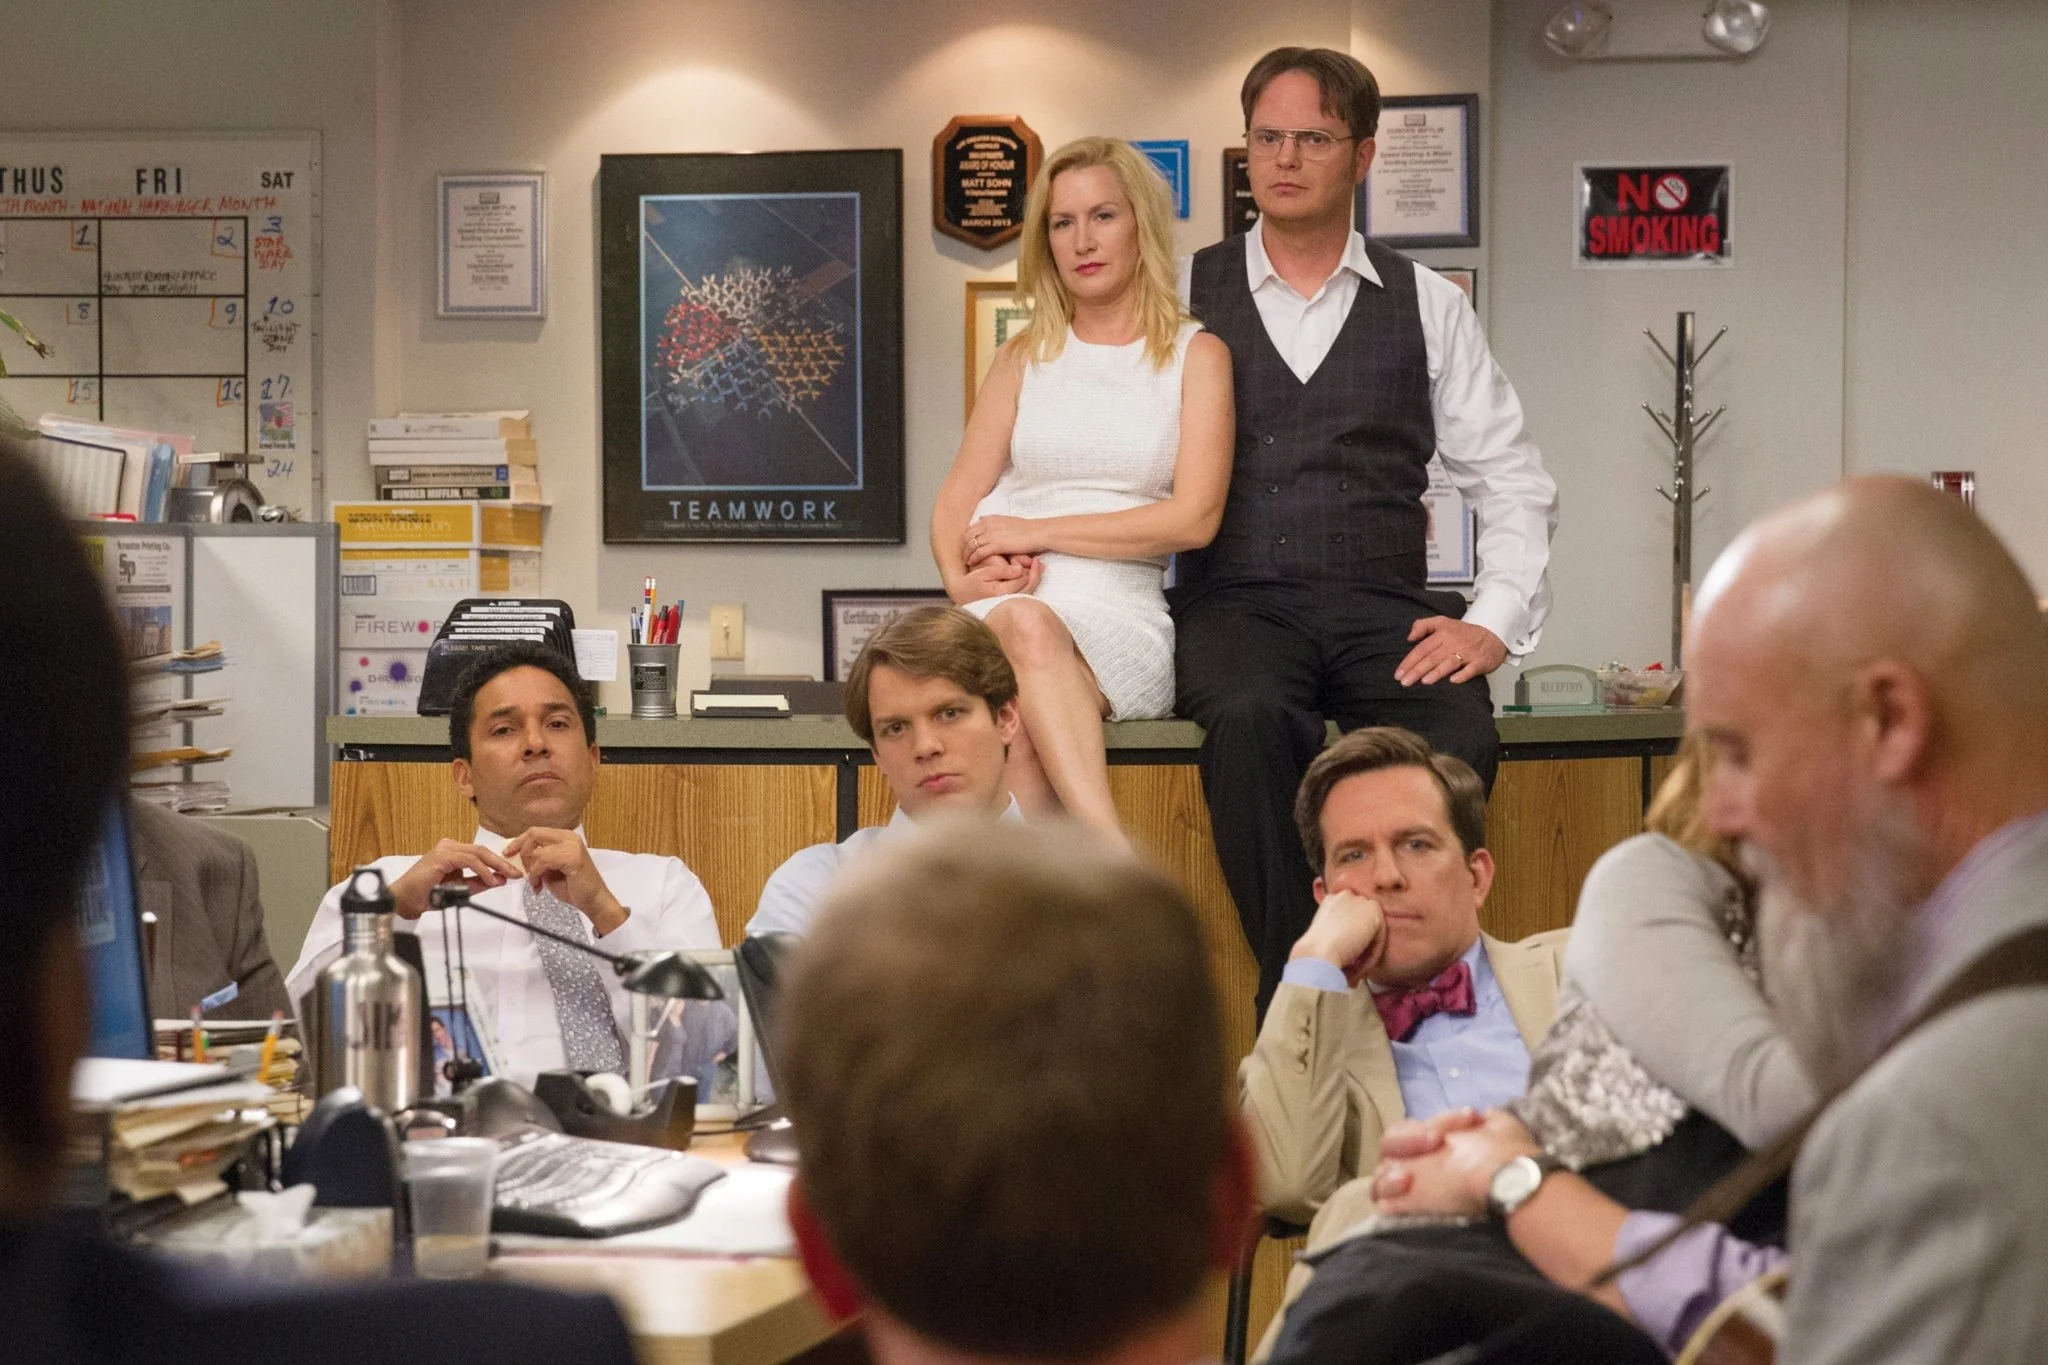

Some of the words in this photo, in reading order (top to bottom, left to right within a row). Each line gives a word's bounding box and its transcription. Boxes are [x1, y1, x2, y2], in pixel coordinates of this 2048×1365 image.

[136, 168, 182, 195] FRI
[261, 172, 294, 188] SAT
[219, 196, 278, 212] MONTH
[216, 226, 237, 250] 2
[255, 236, 285, 249] STAR
[1589, 213, 1720, 254] SMOKING
[77, 303, 91, 321] 8
[225, 303, 236, 325] 9
[266, 296, 294, 316] 10
[221, 379, 243, 401] 16
[260, 373, 290, 400] 17
[267, 459, 293, 478] 24
[392, 489, 425, 499] DUNDER
[669, 500, 836, 520] TEAMWORK
[355, 619, 444, 633] FIREWOR
[1540, 681, 1583, 693] RECEPTION
